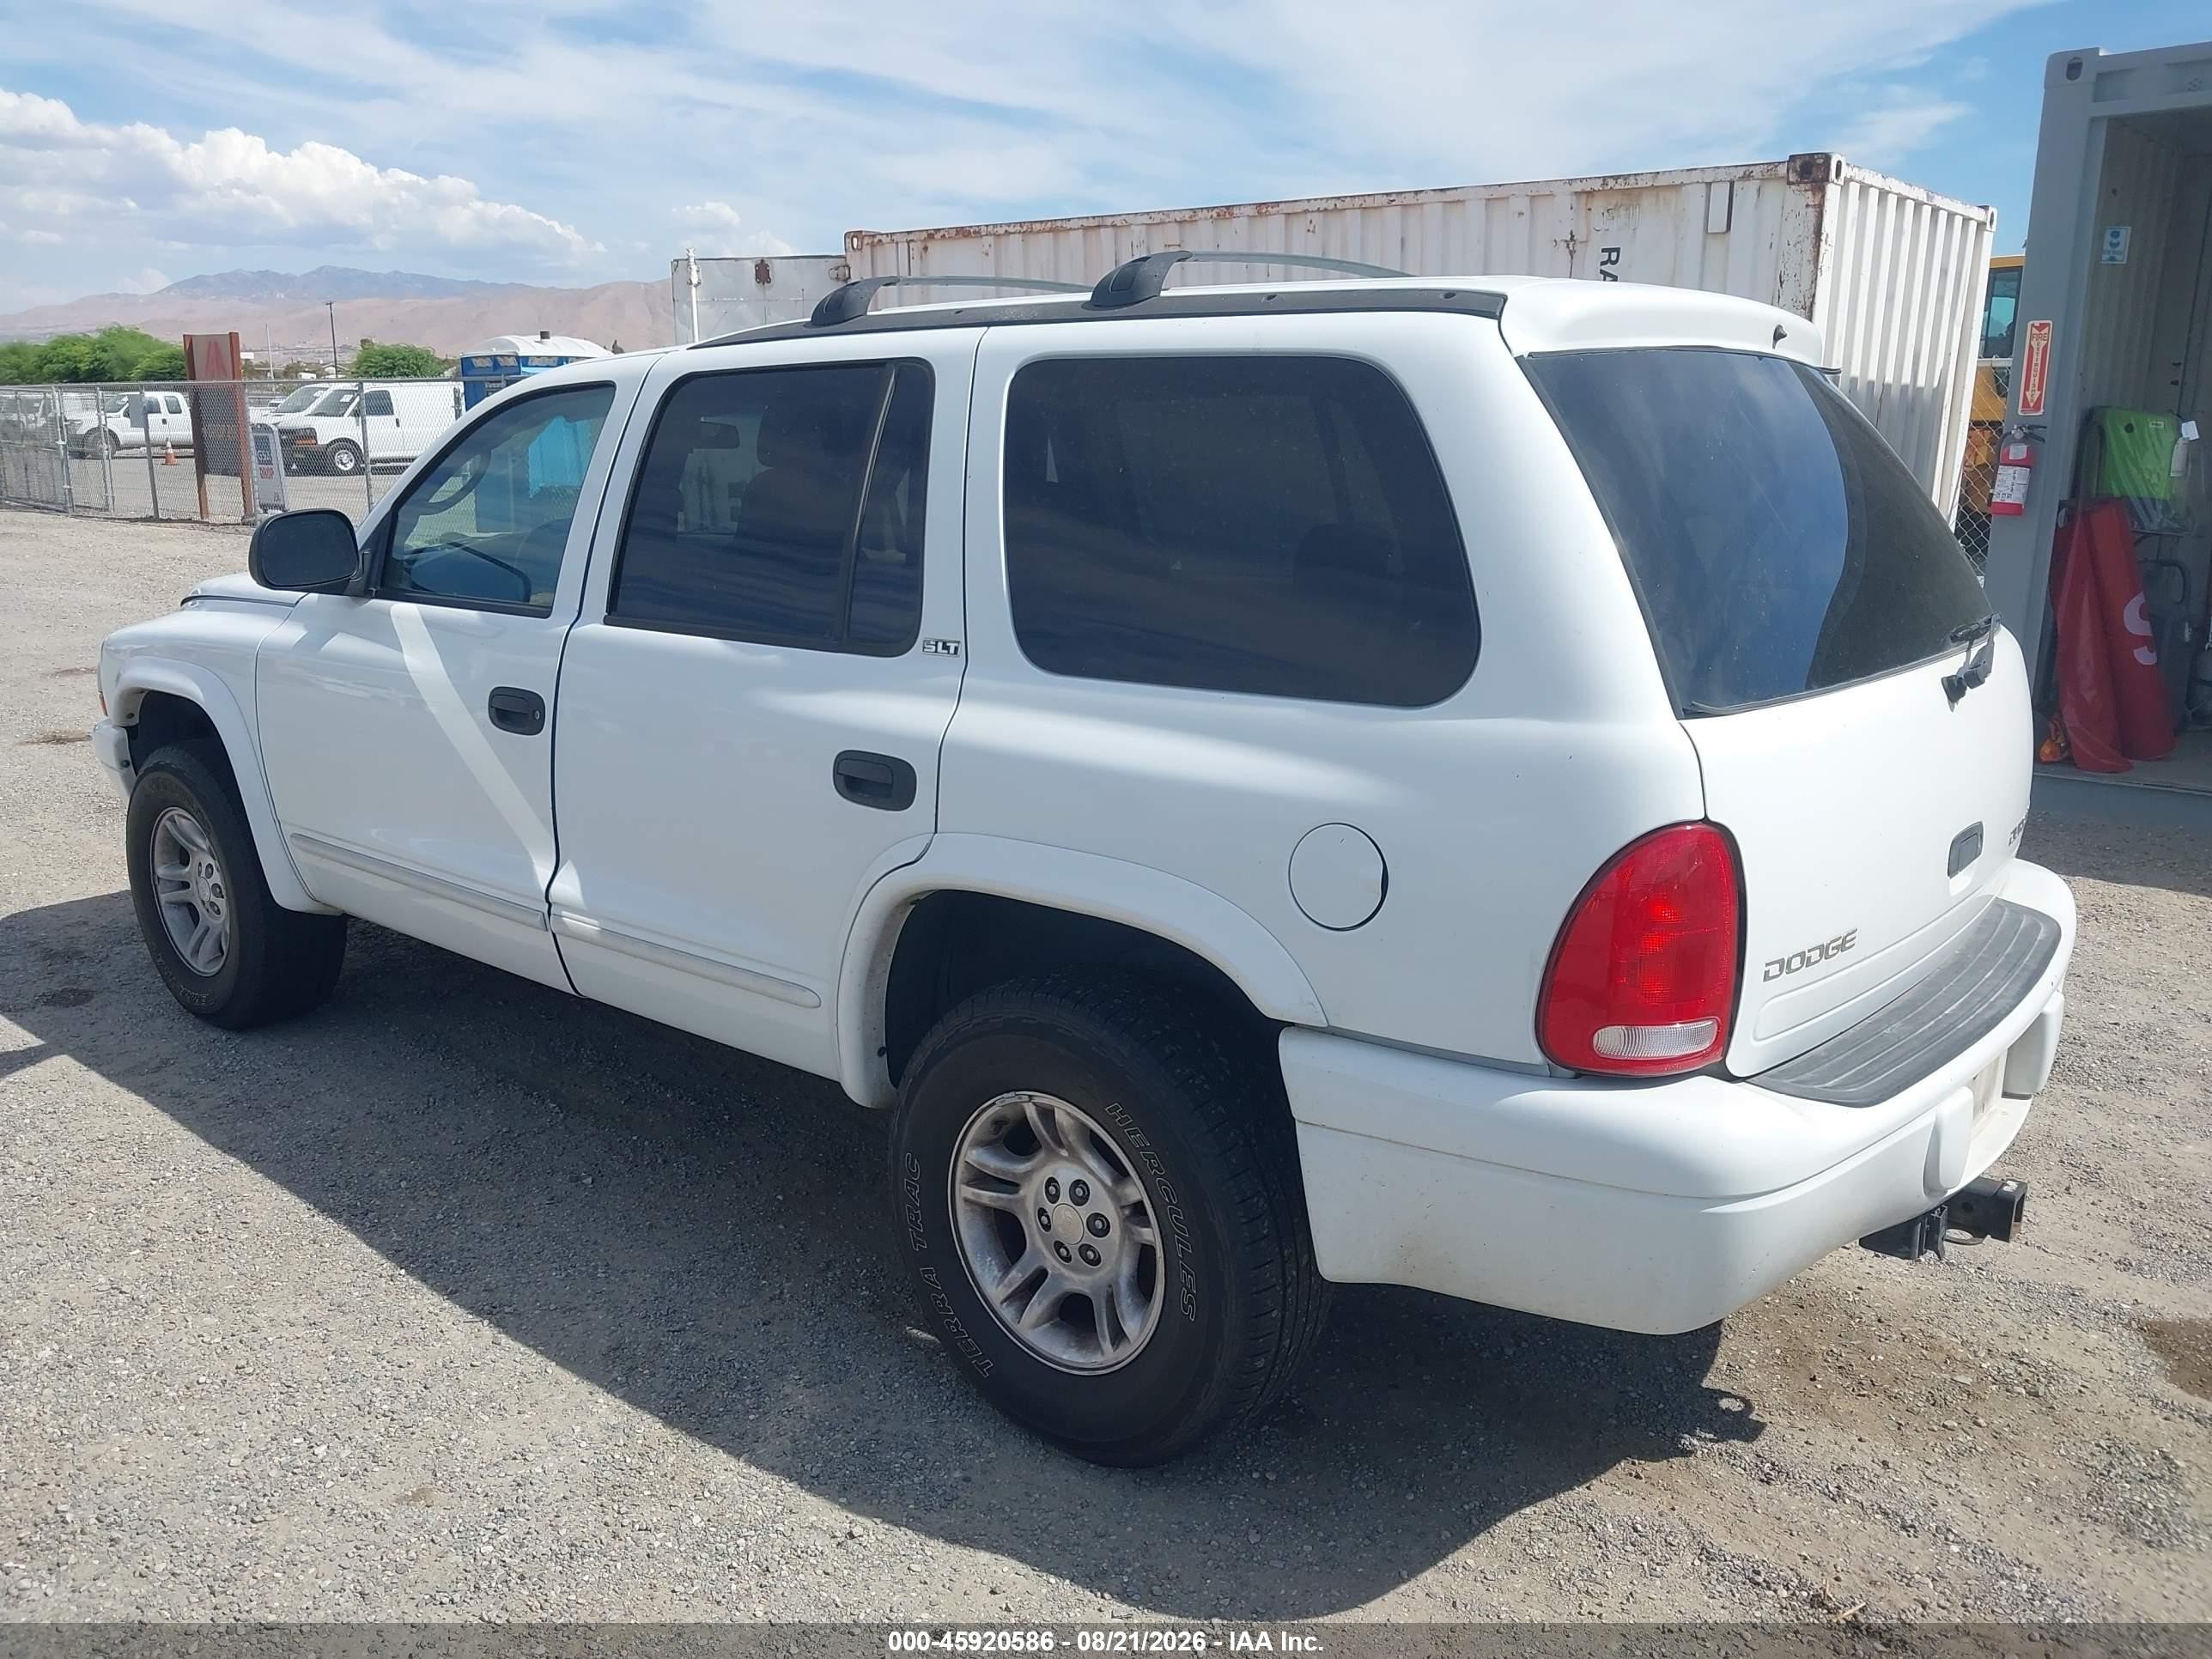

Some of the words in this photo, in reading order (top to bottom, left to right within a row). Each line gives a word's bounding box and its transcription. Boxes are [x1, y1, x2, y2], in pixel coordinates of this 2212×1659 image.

[2031, 332, 2049, 342] FIRE
[2029, 343, 2041, 404] EXTINGUISHER
[923, 641, 959, 654] SLT
[1762, 927, 1858, 983] DODGE
[903, 1152, 928, 1253] TRAC
[1104, 1102, 1197, 1322] HERCULES
[920, 1267, 994, 1379] TERRA
